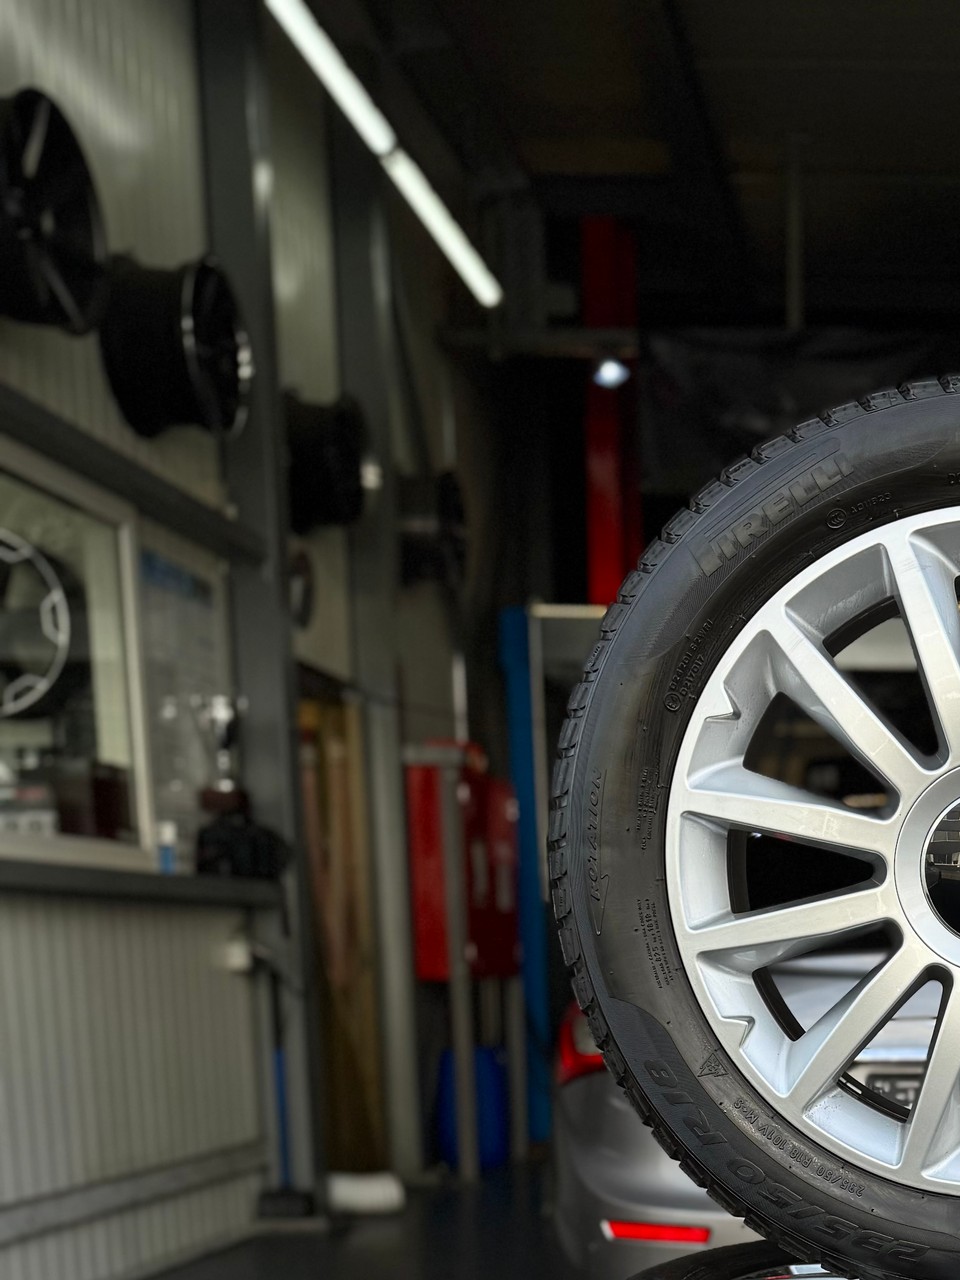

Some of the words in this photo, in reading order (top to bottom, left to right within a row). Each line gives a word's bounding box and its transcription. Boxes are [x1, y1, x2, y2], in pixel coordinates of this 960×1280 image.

[643, 1058, 729, 1147] R18
[757, 1123, 787, 1151] 101V
[789, 1147, 813, 1168] R18
[816, 1165, 866, 1198] 235/50
[728, 1157, 929, 1264] 235/50
